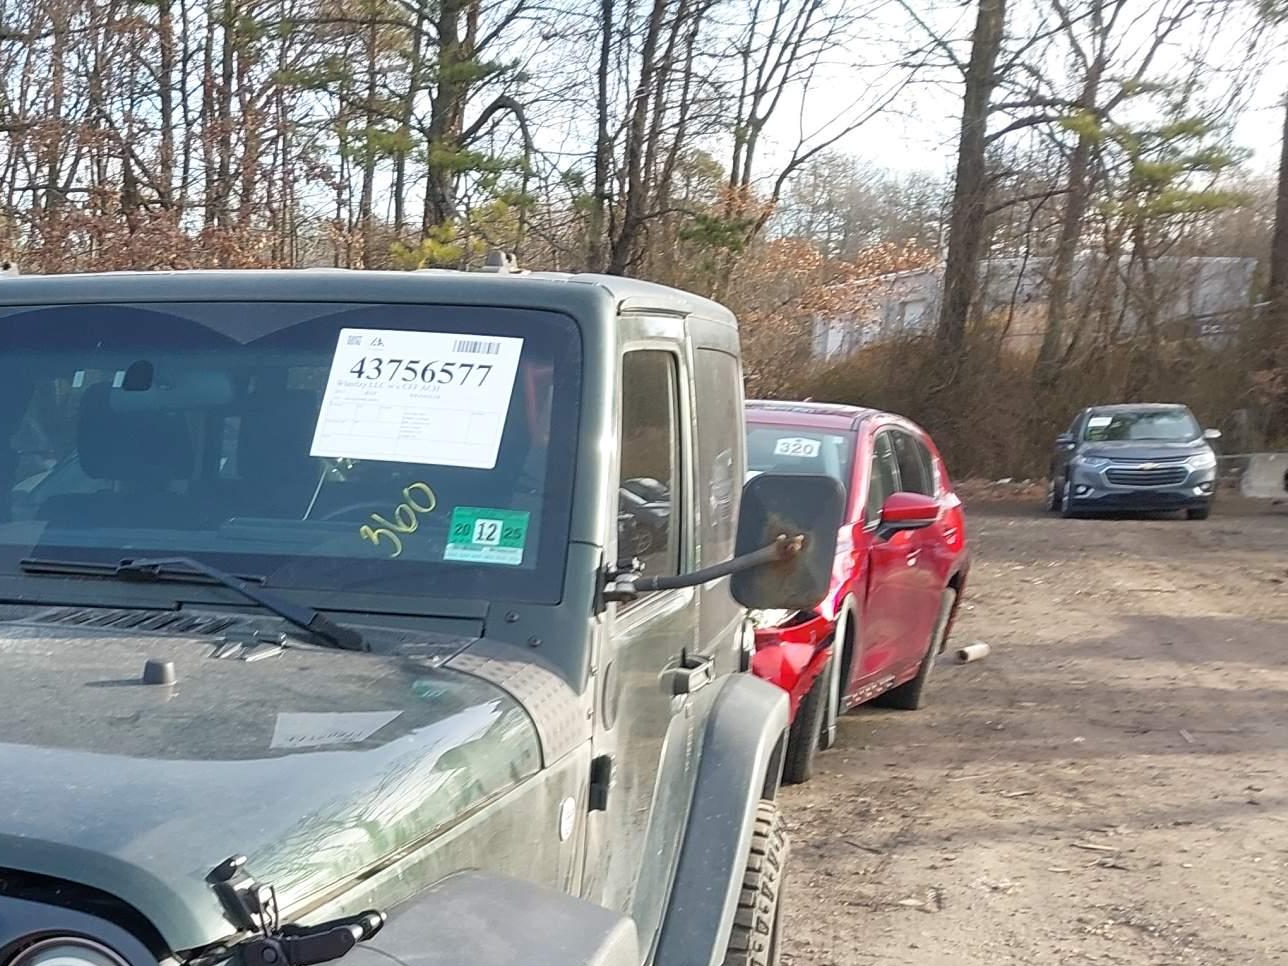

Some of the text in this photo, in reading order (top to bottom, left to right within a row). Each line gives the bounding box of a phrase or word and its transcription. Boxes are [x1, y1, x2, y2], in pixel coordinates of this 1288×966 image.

[350, 356, 493, 388] 43756577
[779, 442, 813, 455] 320
[359, 481, 438, 559] 360
[455, 521, 523, 542] 20 12 25
